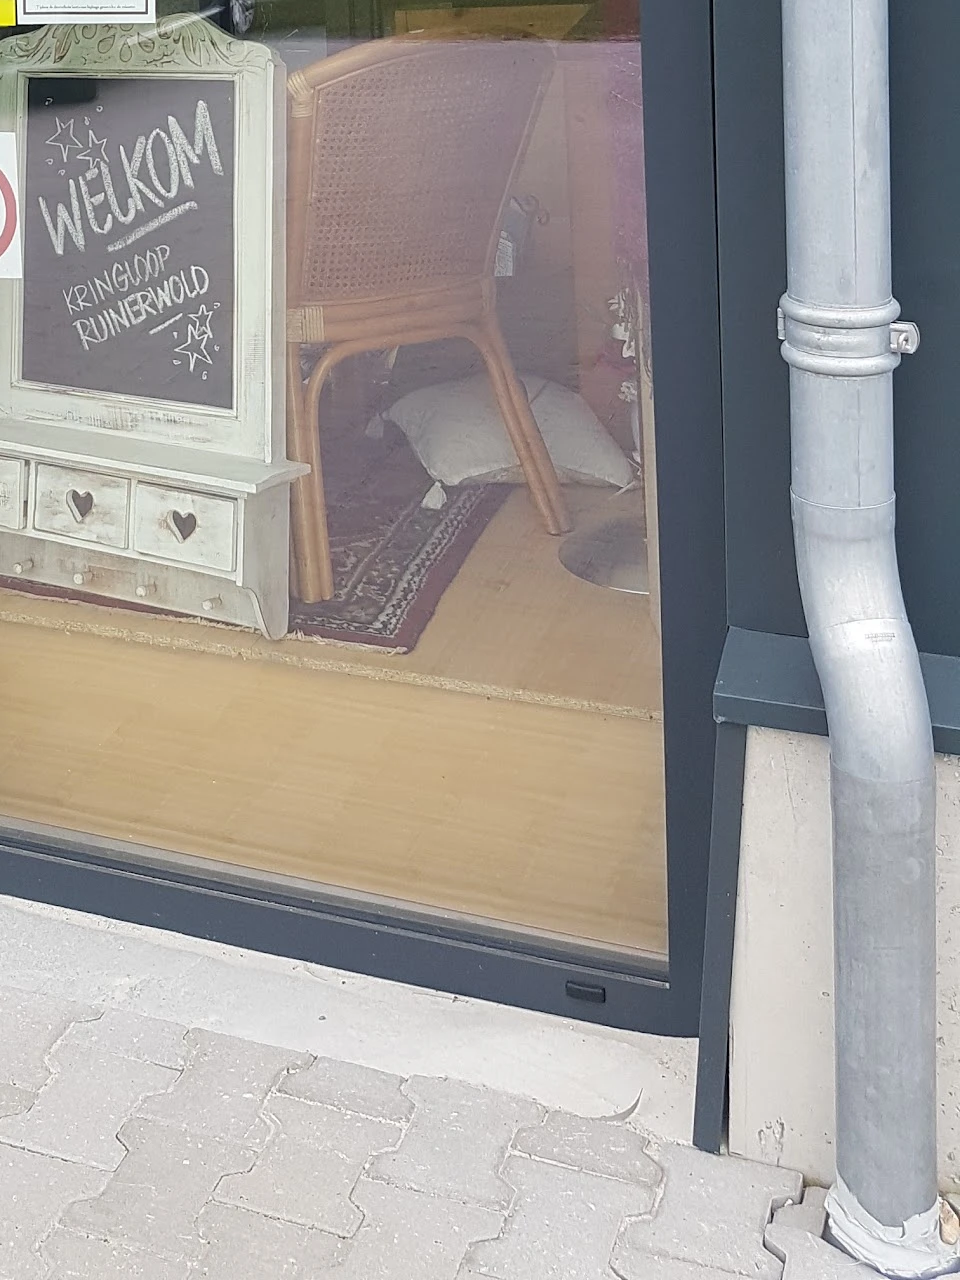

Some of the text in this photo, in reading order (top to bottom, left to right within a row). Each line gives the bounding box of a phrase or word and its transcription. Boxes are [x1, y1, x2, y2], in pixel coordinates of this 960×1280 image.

[39, 100, 224, 256] WELKOM
[62, 245, 170, 316] KRINGLOOP
[71, 265, 210, 351] RUINERWOLD
